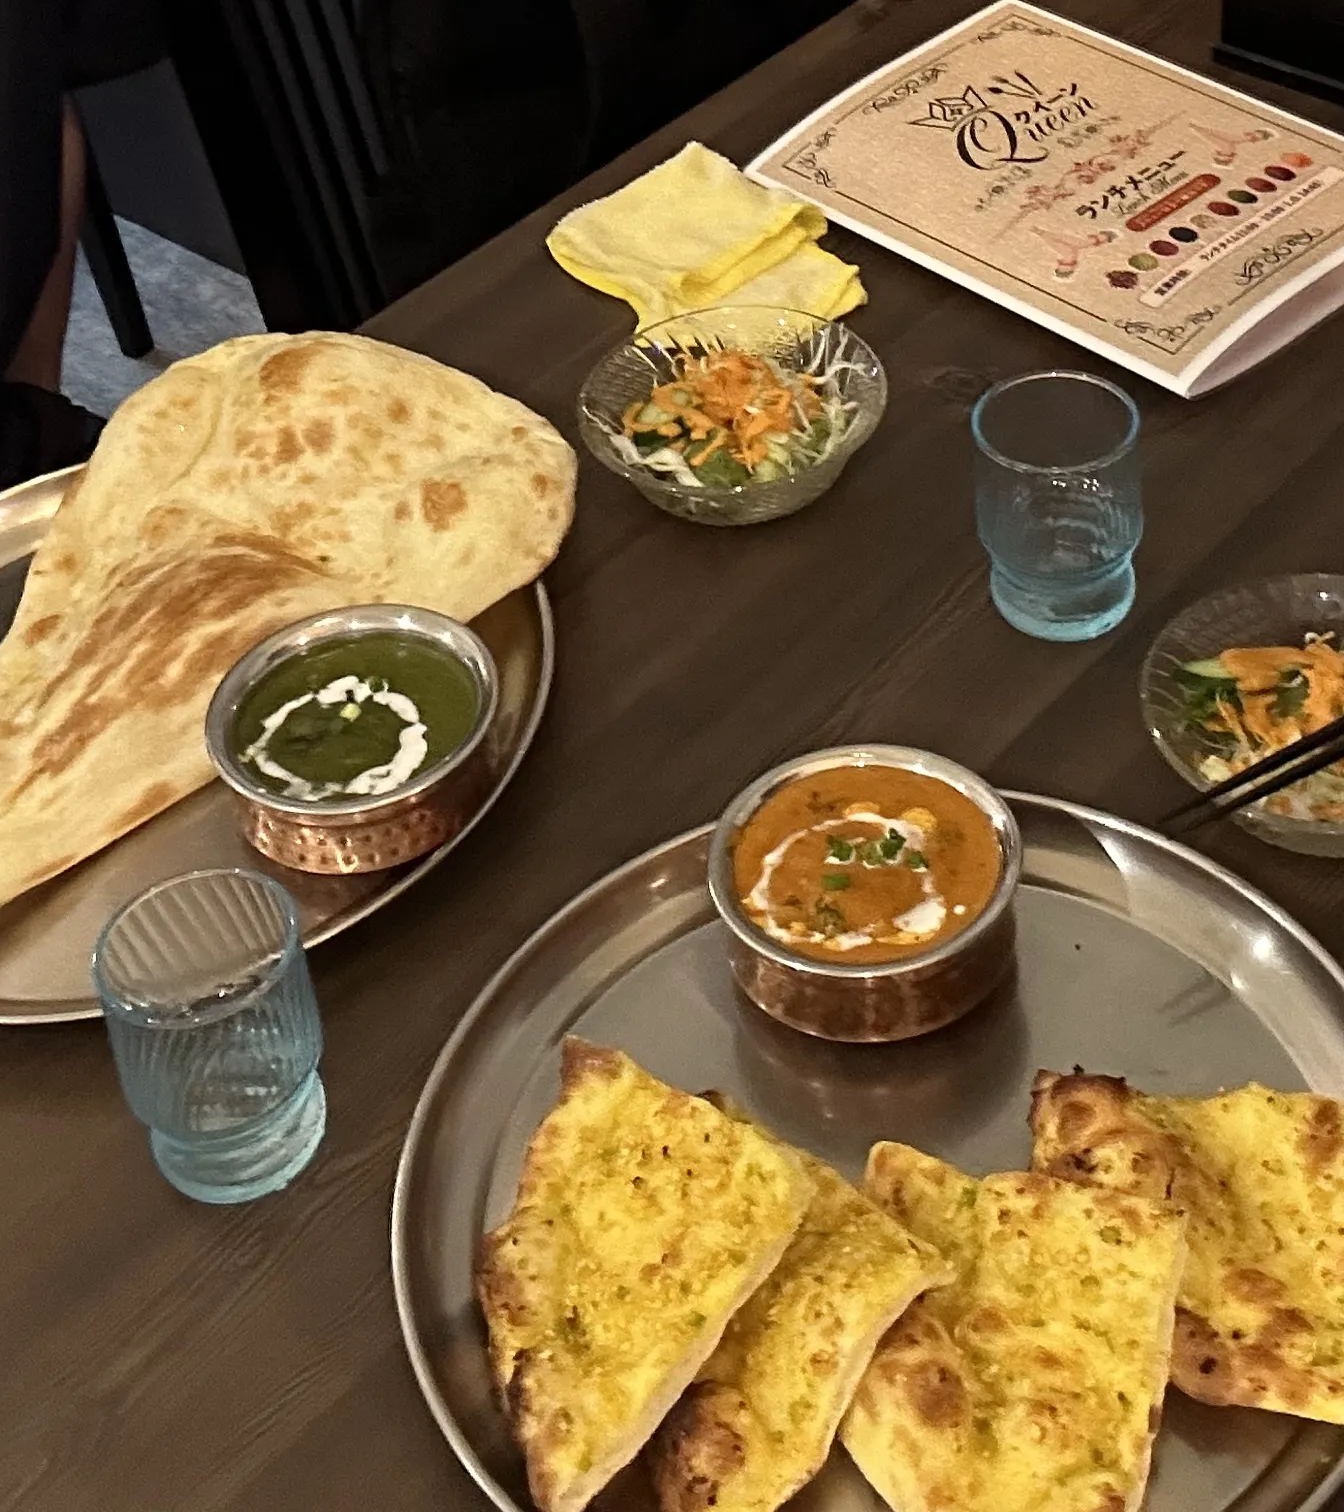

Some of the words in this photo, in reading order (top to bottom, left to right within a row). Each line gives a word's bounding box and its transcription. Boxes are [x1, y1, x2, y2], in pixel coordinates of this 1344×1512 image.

[957, 97, 1099, 170] Queen
[1014, 83, 1077, 124] クイーン
[1075, 150, 1186, 219] ランチメニュー
